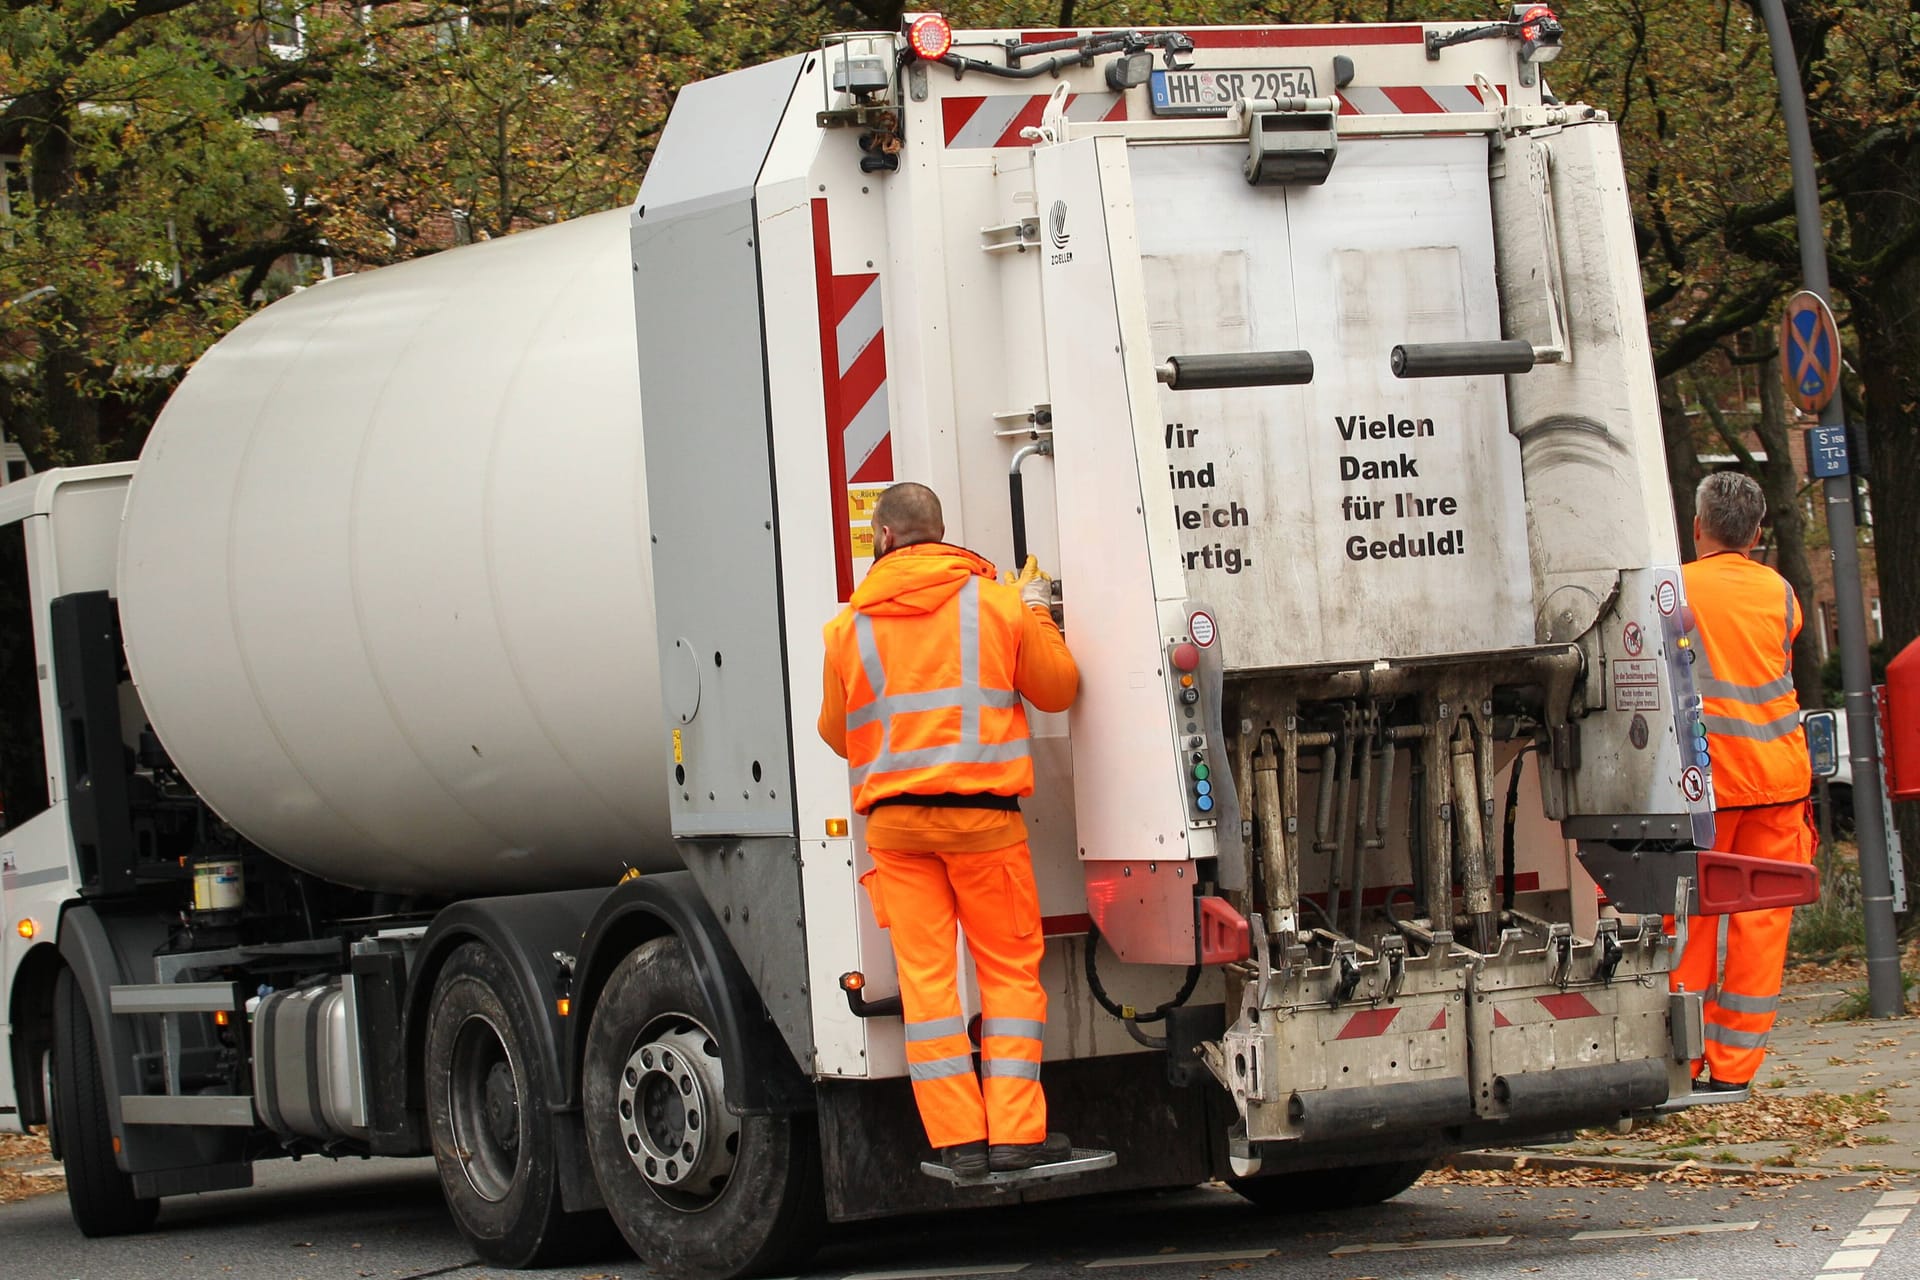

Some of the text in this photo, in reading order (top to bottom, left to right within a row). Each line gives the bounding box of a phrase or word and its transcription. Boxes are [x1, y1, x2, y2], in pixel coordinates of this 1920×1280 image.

[1157, 73, 1311, 103] D HH SR 2954
[1051, 252, 1073, 266] ZOELLER
[1334, 414, 1435, 441] Vielen
[1819, 433, 1829, 445] S
[1169, 462, 1216, 489] ind
[1339, 453, 1419, 481] Dank
[1174, 501, 1249, 530] leich
[1341, 492, 1457, 521] für Ihre
[1181, 543, 1252, 575] rtig.
[1345, 530, 1465, 561] Geduld!
